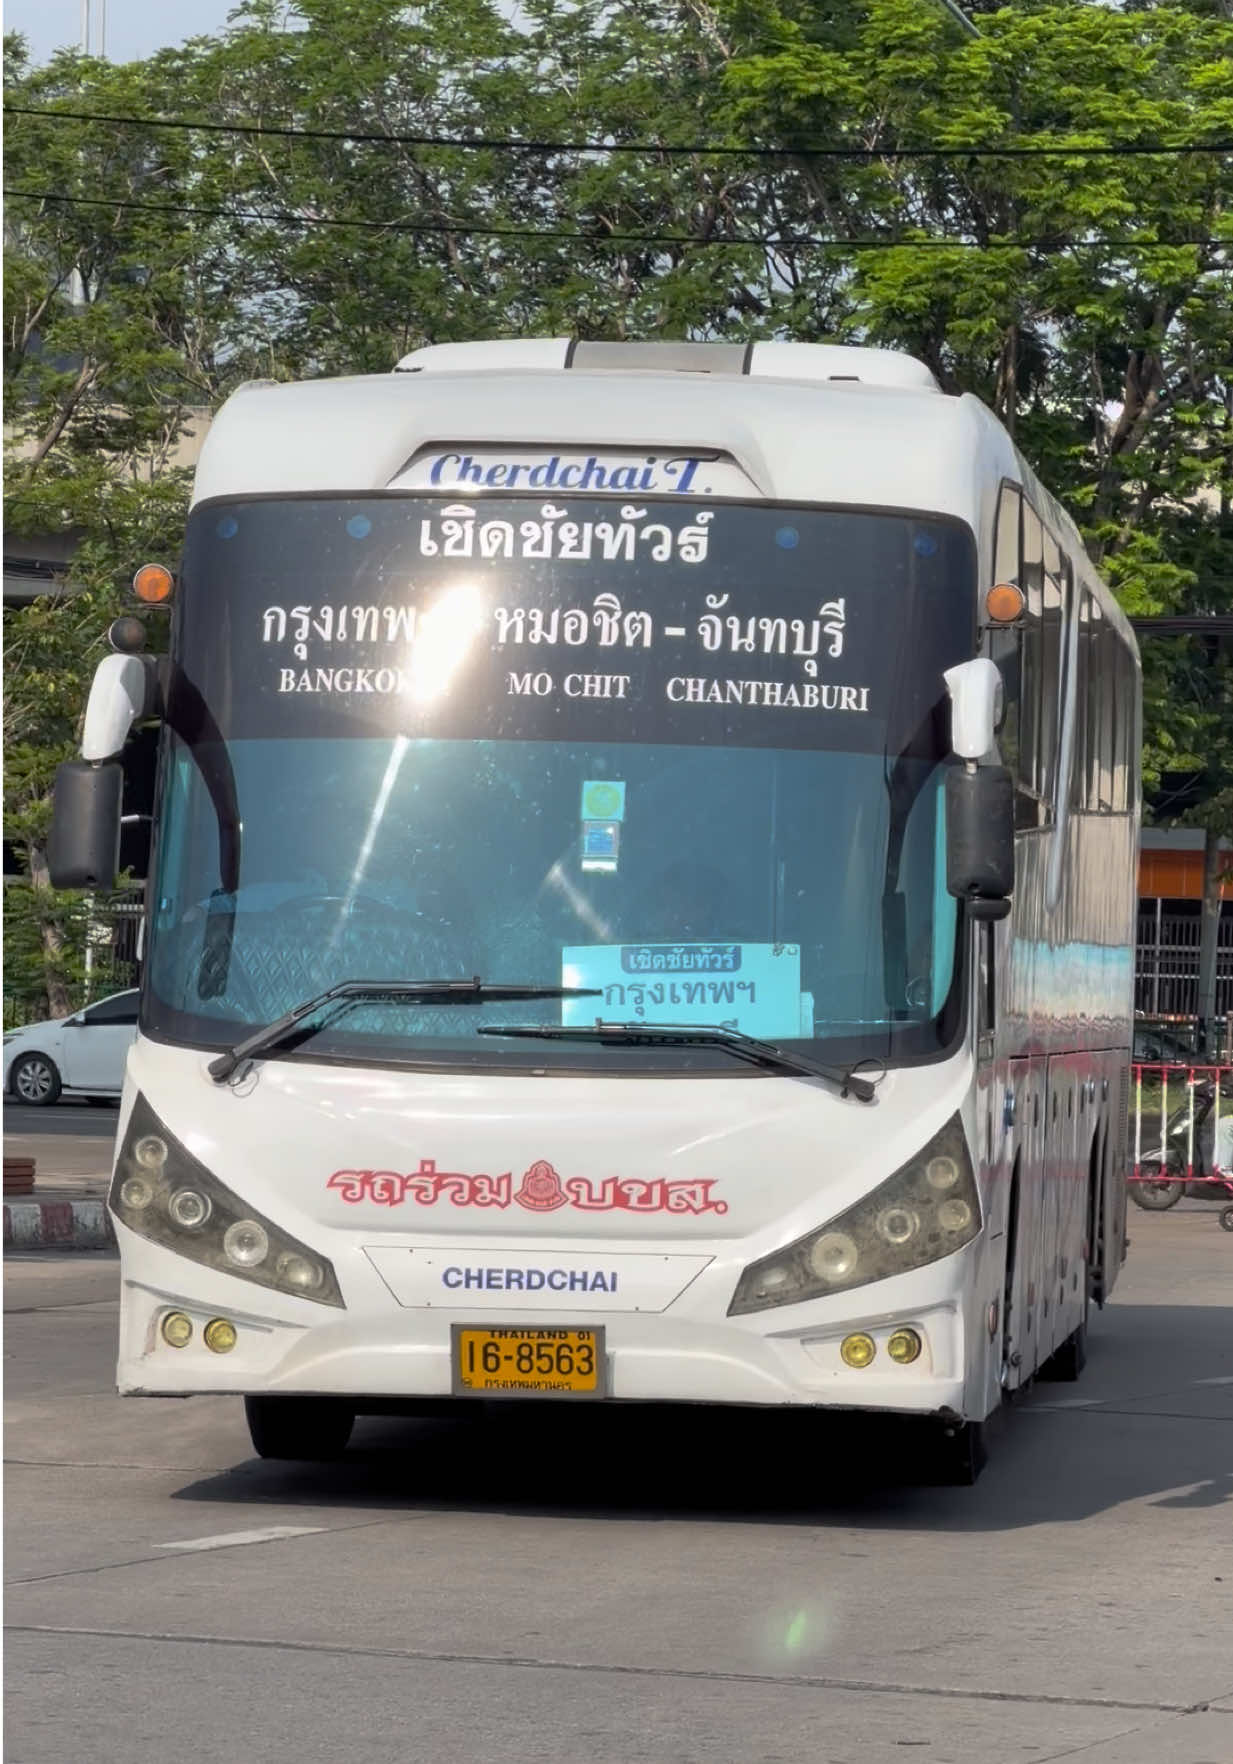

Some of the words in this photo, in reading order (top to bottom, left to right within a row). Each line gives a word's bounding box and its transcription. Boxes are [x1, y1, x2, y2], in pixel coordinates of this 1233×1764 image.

[430, 453, 658, 492] Cherdchai
[420, 503, 714, 564] เชิดชัยทัวร์
[494, 592, 653, 647] หมอชิต
[697, 592, 847, 677] จันทบุรี
[508, 671, 553, 696] MO
[563, 673, 630, 698] CHIT
[666, 676, 870, 712] CHANTHABURI
[629, 946, 736, 970] เชิดชัยทัวร์
[604, 980, 757, 1016] กรุงเทพฯ
[326, 1158, 512, 1209] รถร่วม
[442, 1267, 618, 1292] CHERDCHAI
[489, 1329, 569, 1339] THAILAND
[468, 1340, 595, 1376] 16-8563
